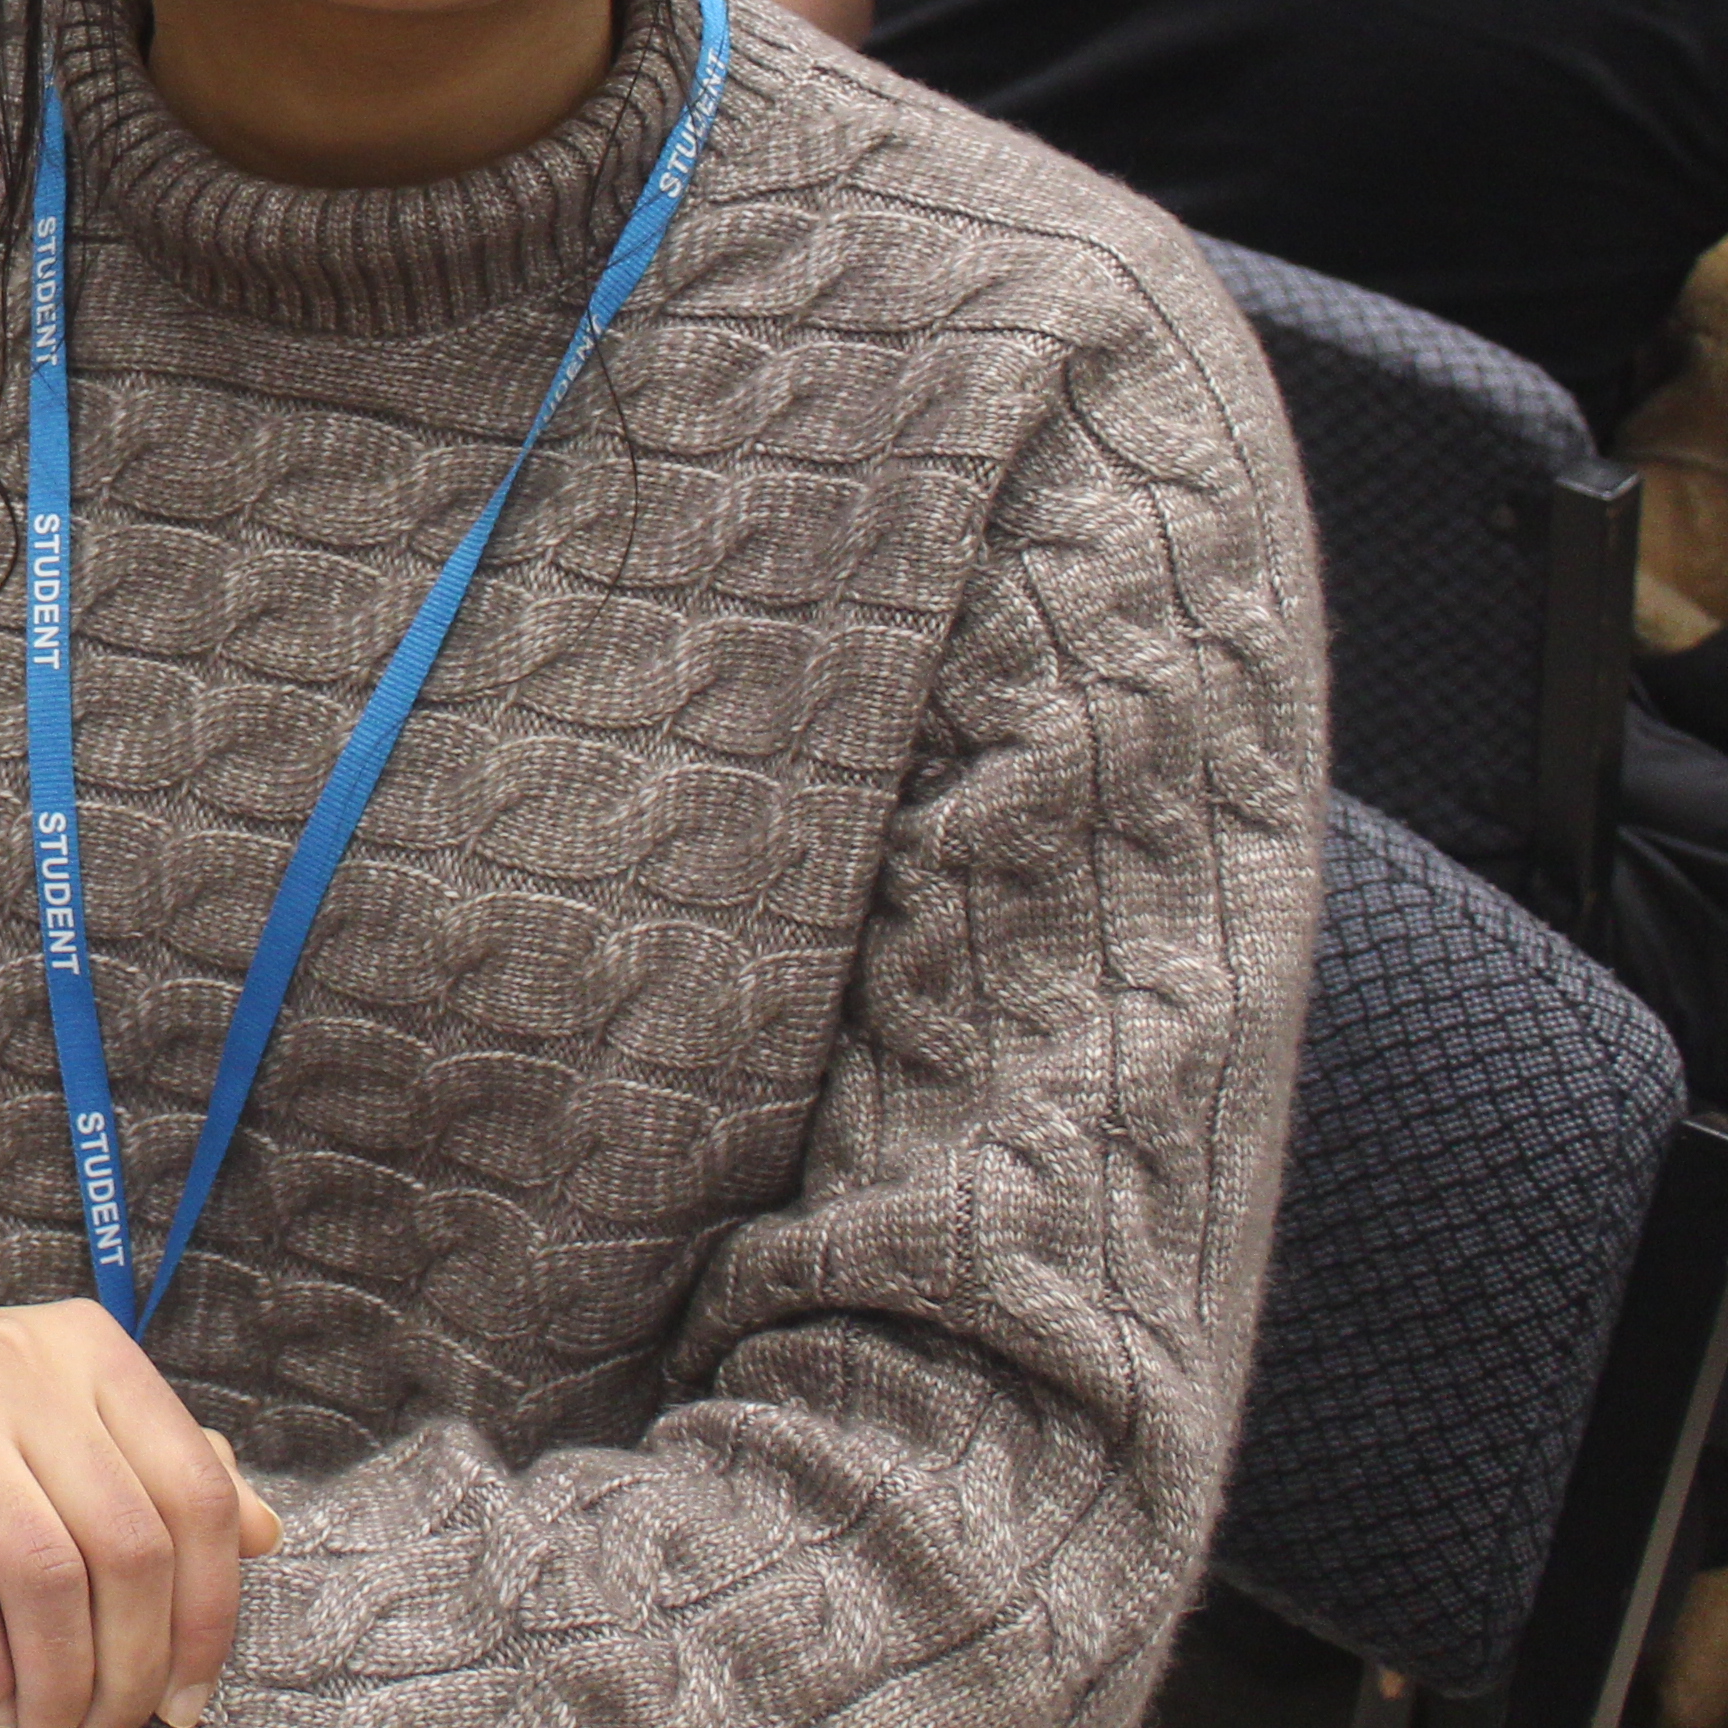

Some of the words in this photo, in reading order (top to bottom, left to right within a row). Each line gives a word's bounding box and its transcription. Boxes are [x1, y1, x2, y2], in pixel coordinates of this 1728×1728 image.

[658, 47, 728, 200] STUDENT
[34, 215, 62, 368] STUDENT
[31, 513, 62, 671] STUDENT
[37, 811, 81, 977] STUDENT
[76, 1110, 125, 1268] STUDENT
